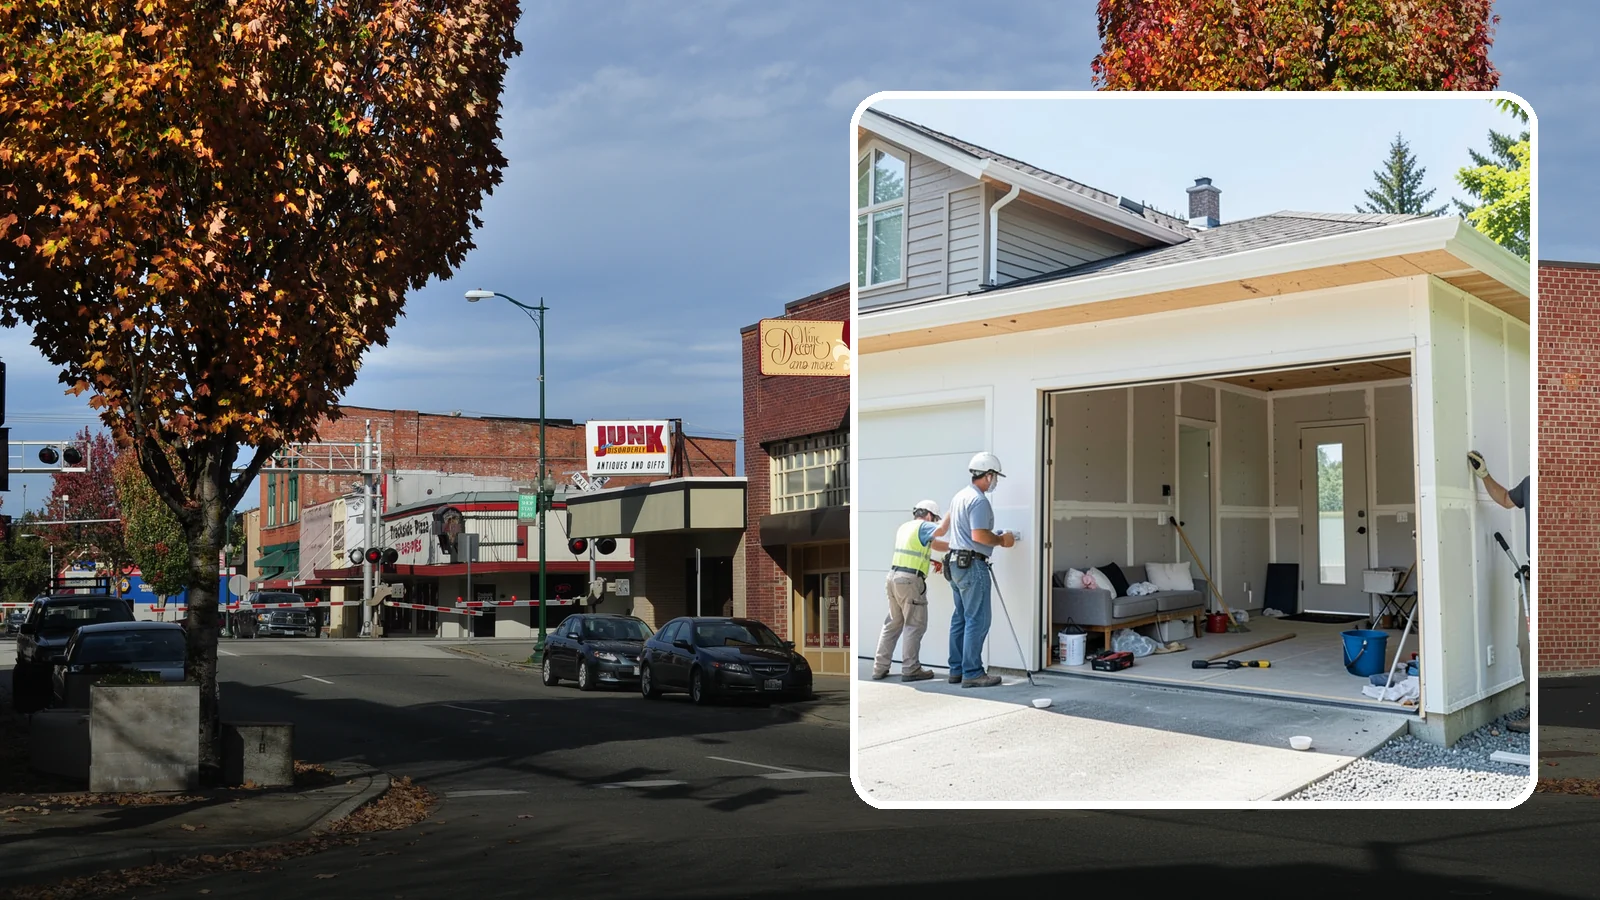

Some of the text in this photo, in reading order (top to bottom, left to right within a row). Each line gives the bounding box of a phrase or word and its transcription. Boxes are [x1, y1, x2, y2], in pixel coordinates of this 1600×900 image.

[765, 328, 831, 365] Decor
[595, 425, 664, 457] JUNK
[607, 446, 645, 454] DISORDERLY
[597, 460, 665, 470] ANTIQUES AND GIFTS
